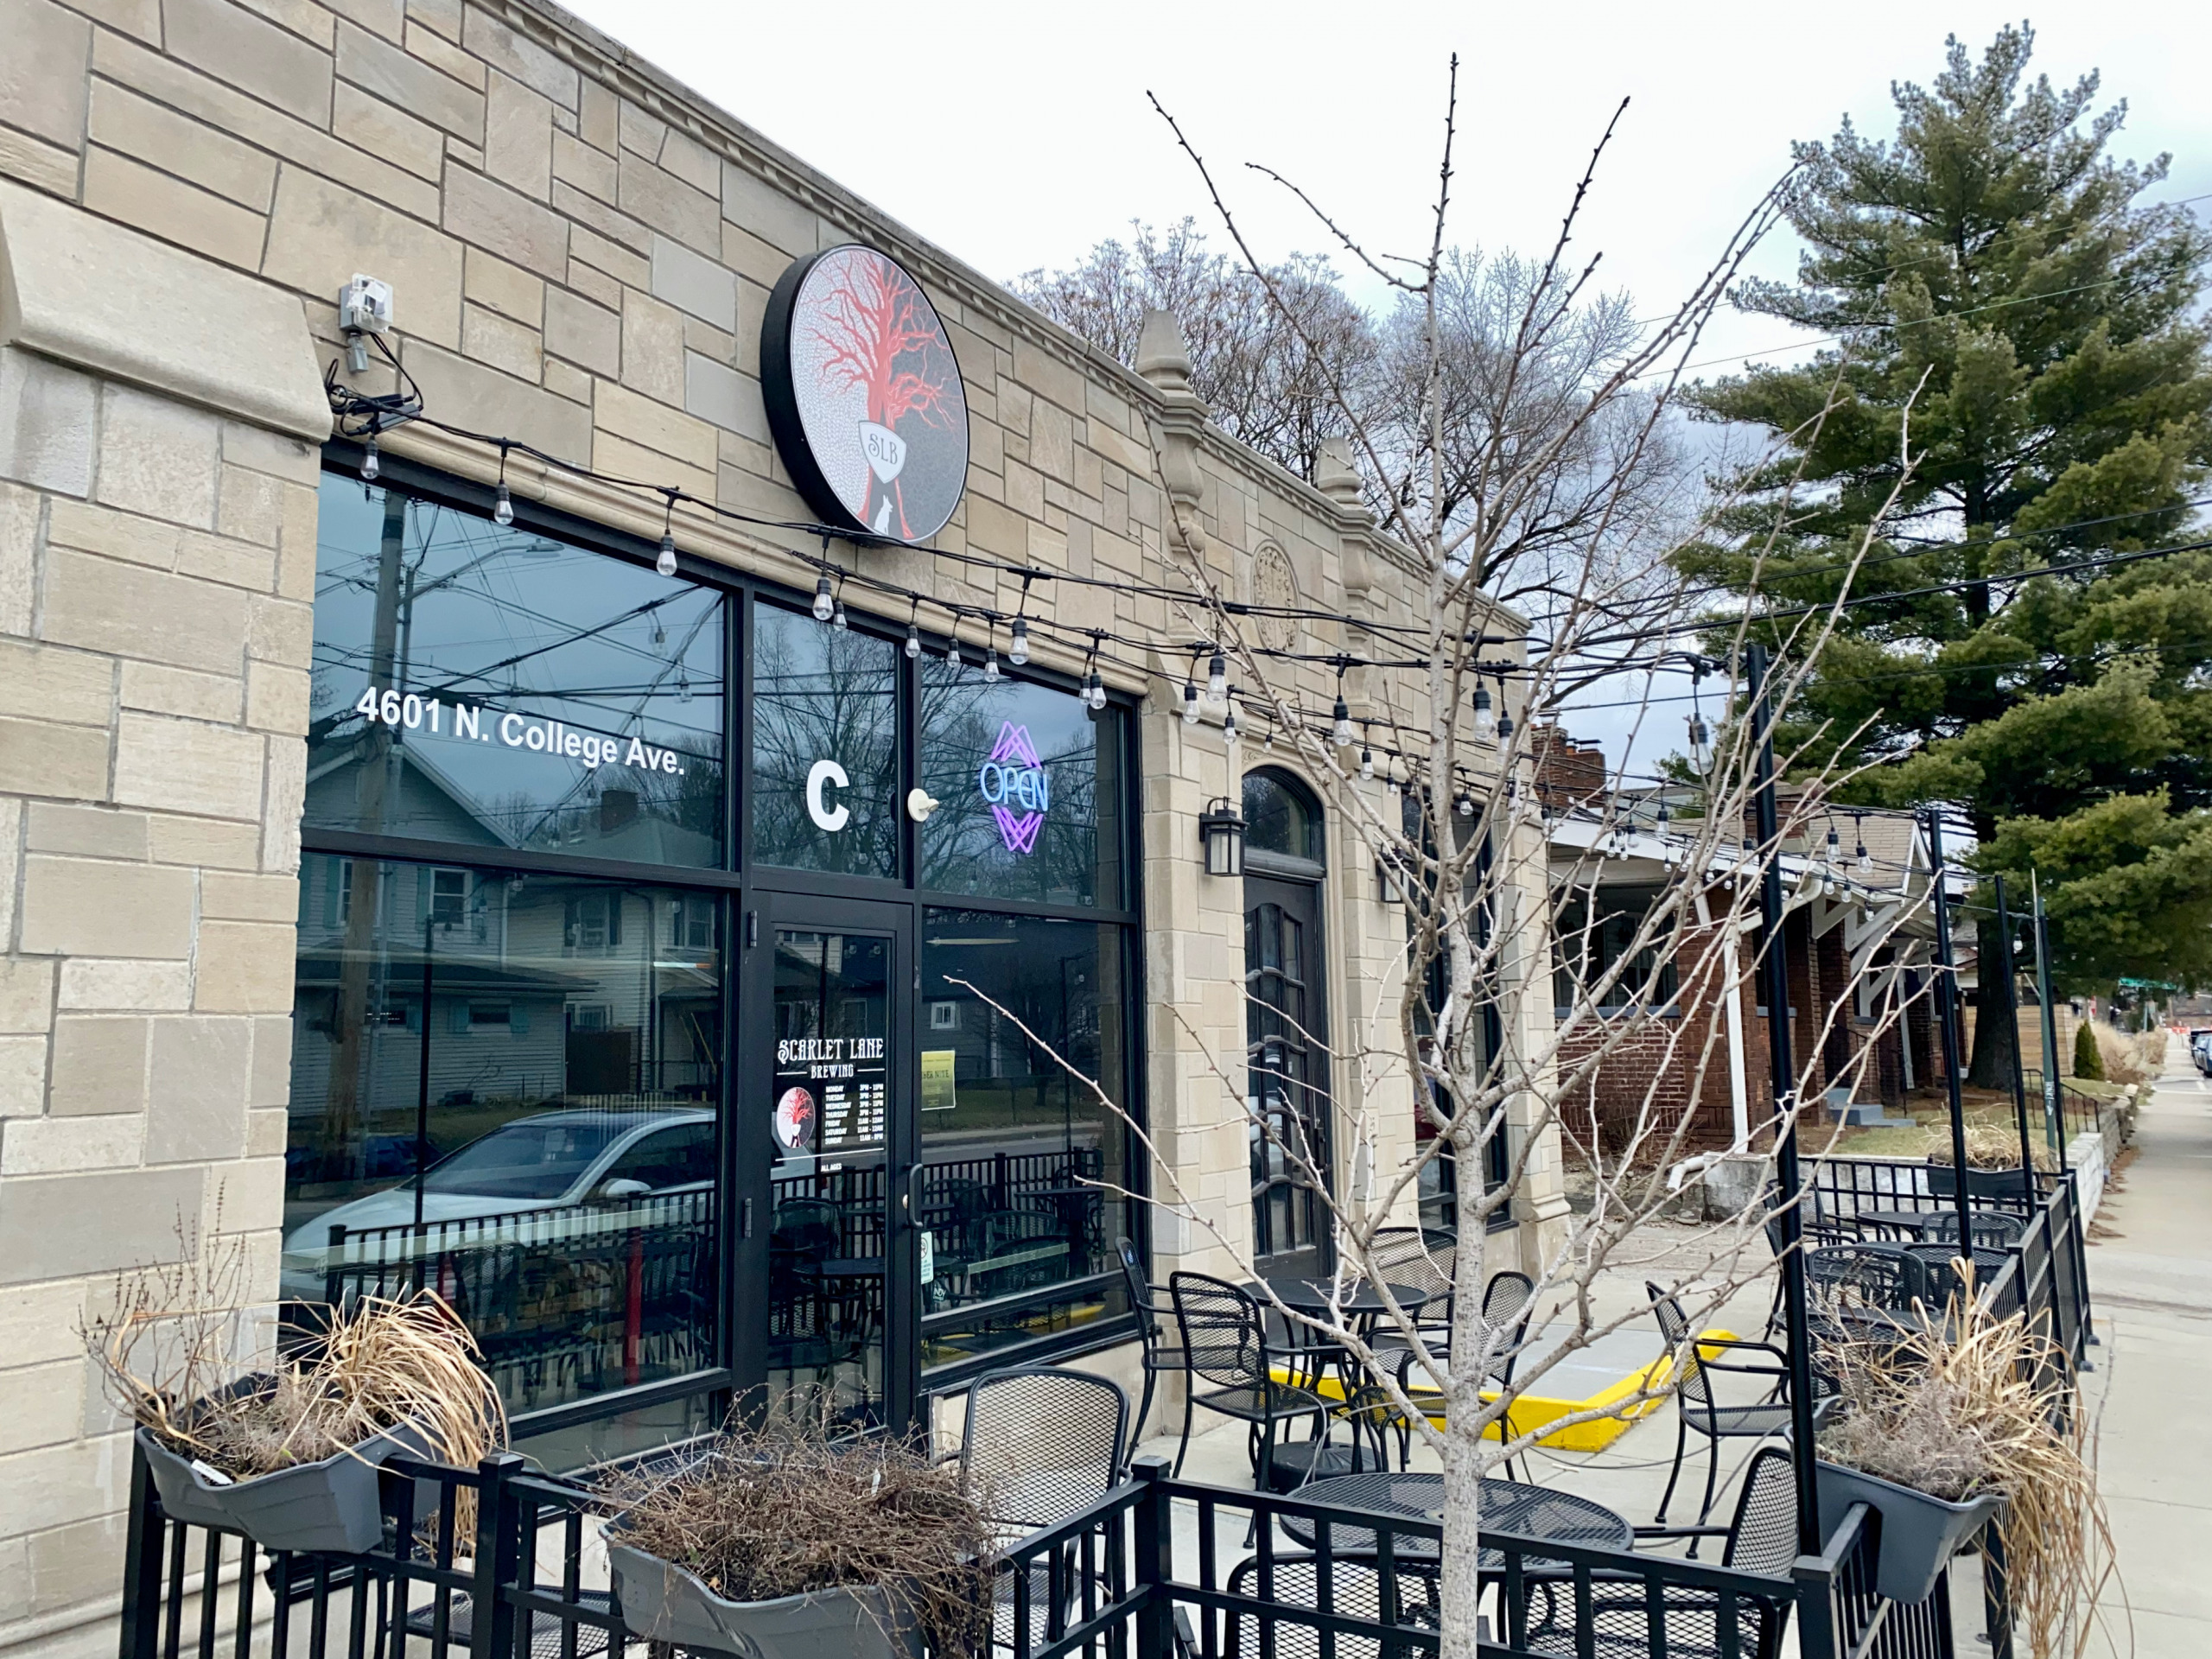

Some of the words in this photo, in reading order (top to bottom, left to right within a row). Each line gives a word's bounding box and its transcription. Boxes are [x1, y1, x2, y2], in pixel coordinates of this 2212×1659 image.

[868, 433, 898, 465] SLB
[357, 686, 439, 732] 4601
[455, 703, 488, 741] N.
[501, 713, 619, 768] College
[626, 737, 684, 775] Ave.
[980, 762, 1048, 811] OPEN
[806, 760, 849, 831] C
[778, 1039, 843, 1065] SCARLET
[849, 1038, 884, 1059] LANE
[810, 1064, 854, 1079] BREWING
[825, 1093, 845, 1102] TUESDAY
[825, 1102, 852, 1110] WEDNESDAY
[825, 1110, 848, 1119] THURSDAY
[824, 1119, 841, 1128] FRIDAY
[824, 1127, 848, 1136] SATURDAY
[824, 1136, 842, 1145] SUNDAY
